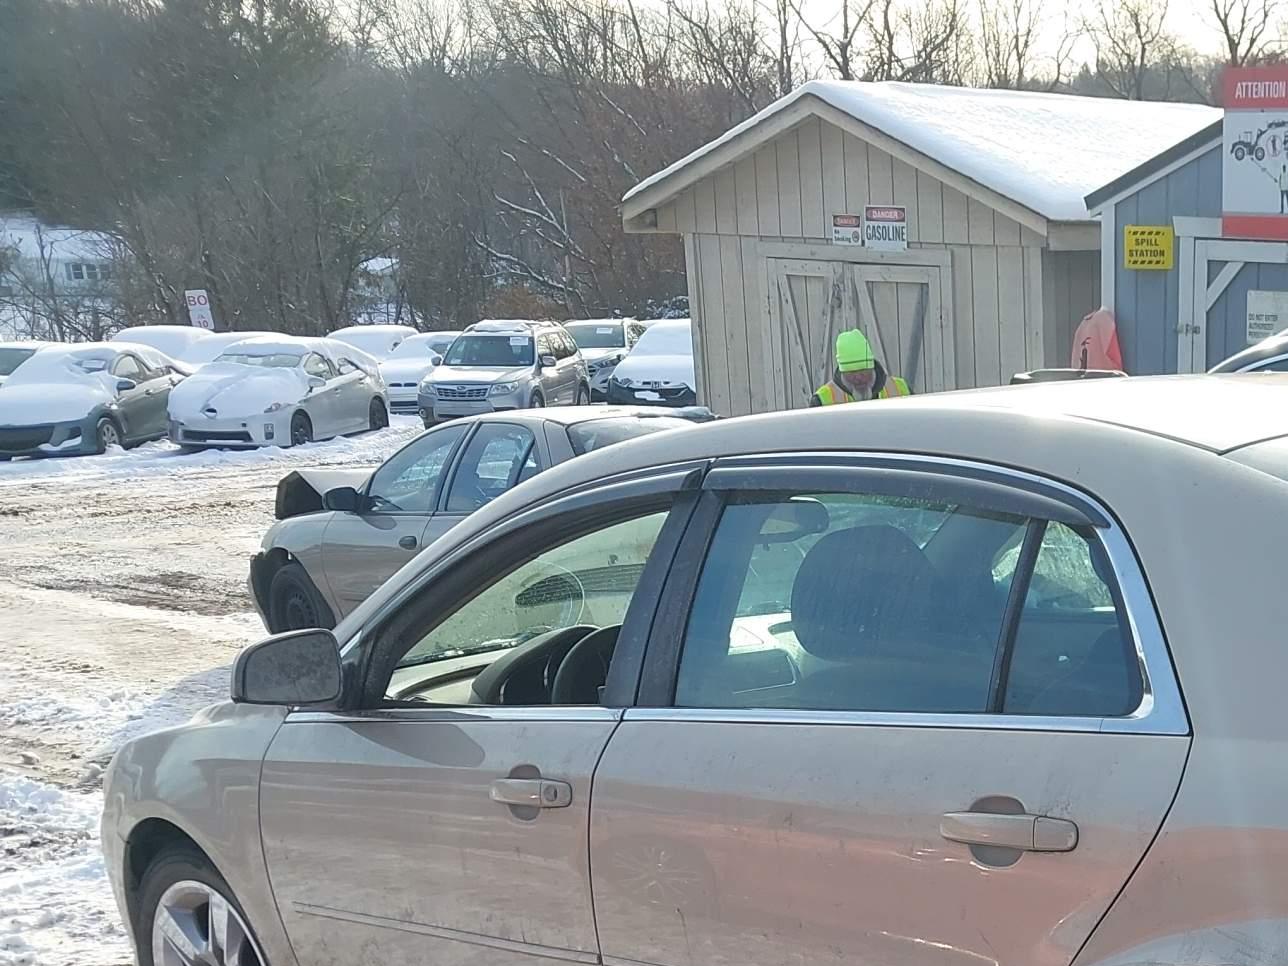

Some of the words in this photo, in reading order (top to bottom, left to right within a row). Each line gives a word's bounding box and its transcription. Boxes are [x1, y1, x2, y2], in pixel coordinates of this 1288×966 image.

[1235, 80, 1286, 99] ATTENTION
[872, 210, 898, 219] DANGER
[866, 224, 906, 241] GASOLINE
[1135, 238, 1159, 247] SPILL
[1129, 249, 1164, 257] STATION
